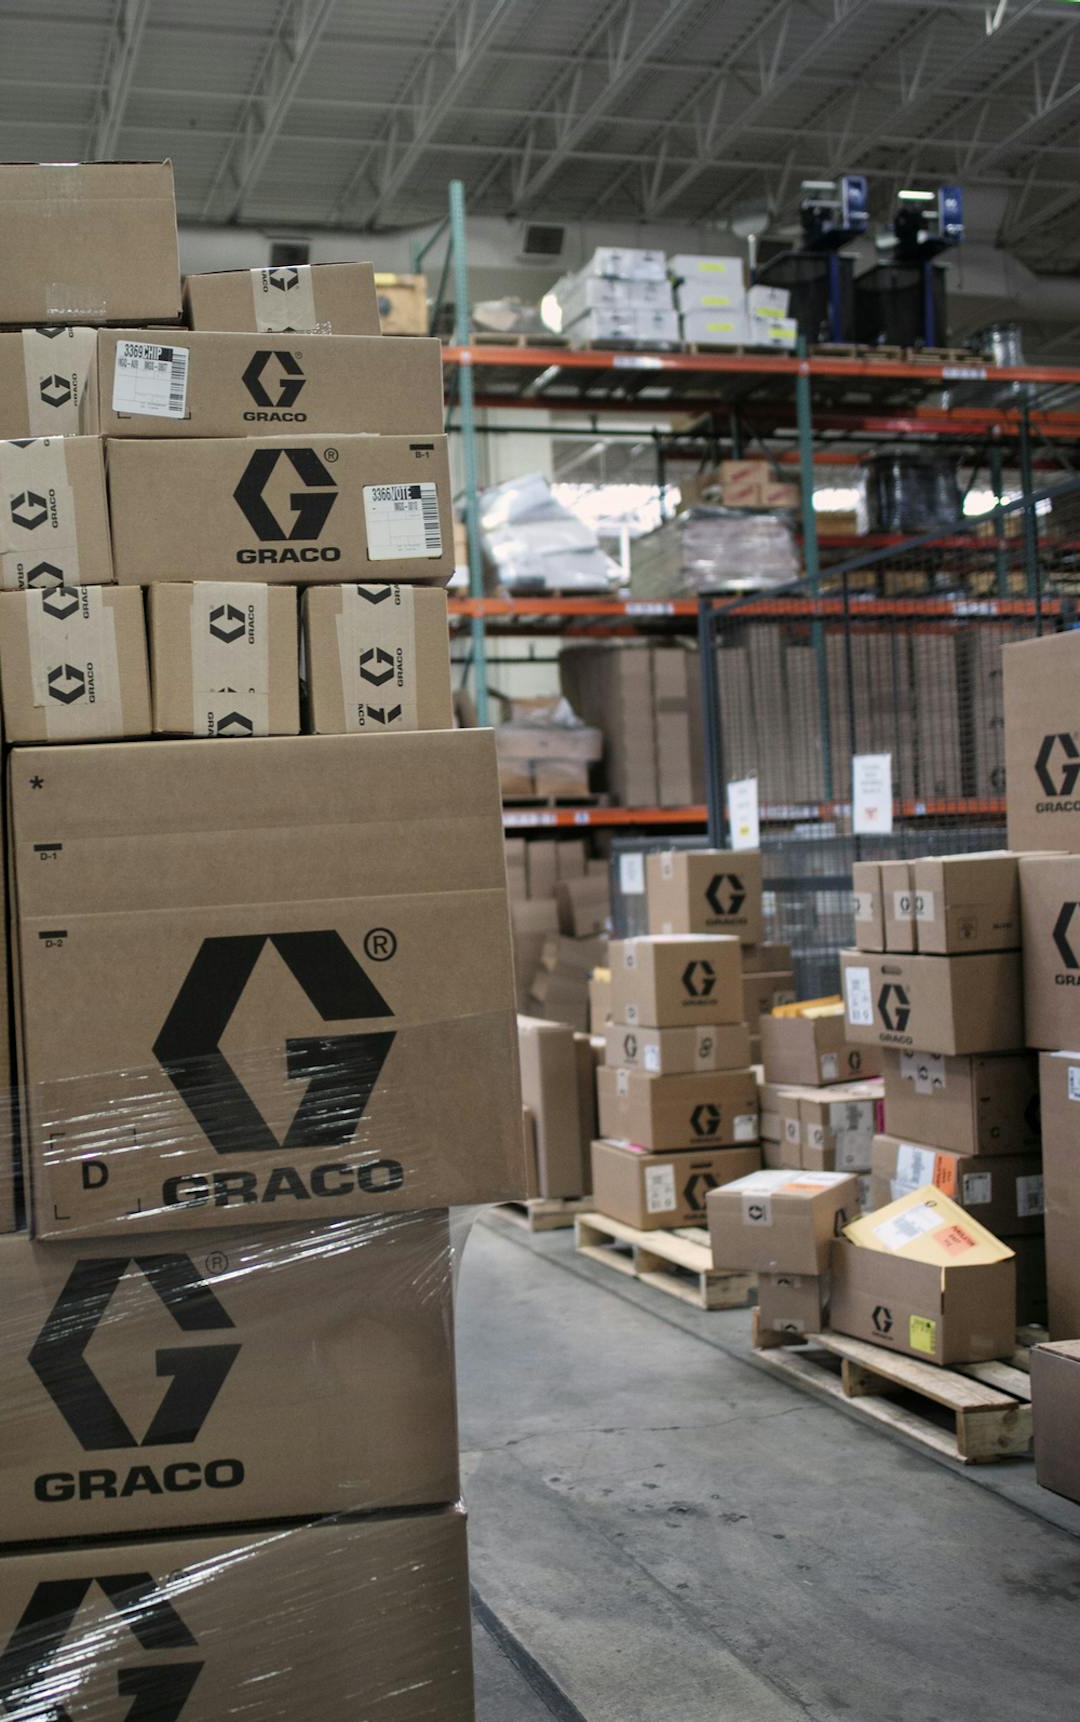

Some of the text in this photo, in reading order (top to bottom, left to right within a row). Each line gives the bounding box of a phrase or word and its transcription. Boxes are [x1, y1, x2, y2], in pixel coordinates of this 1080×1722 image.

[242, 411, 307, 423] GRACO
[48, 488, 58, 529] GRACO
[235, 546, 342, 565] GRACO
[86, 662, 96, 703] GRACO
[396, 647, 404, 687] GRACO
[40, 852, 58, 860] D-1
[45, 939, 63, 948] D-2
[82, 1160, 110, 1190] D
[161, 1158, 406, 1207] GRACO
[33, 1458, 246, 1502] GRACO
